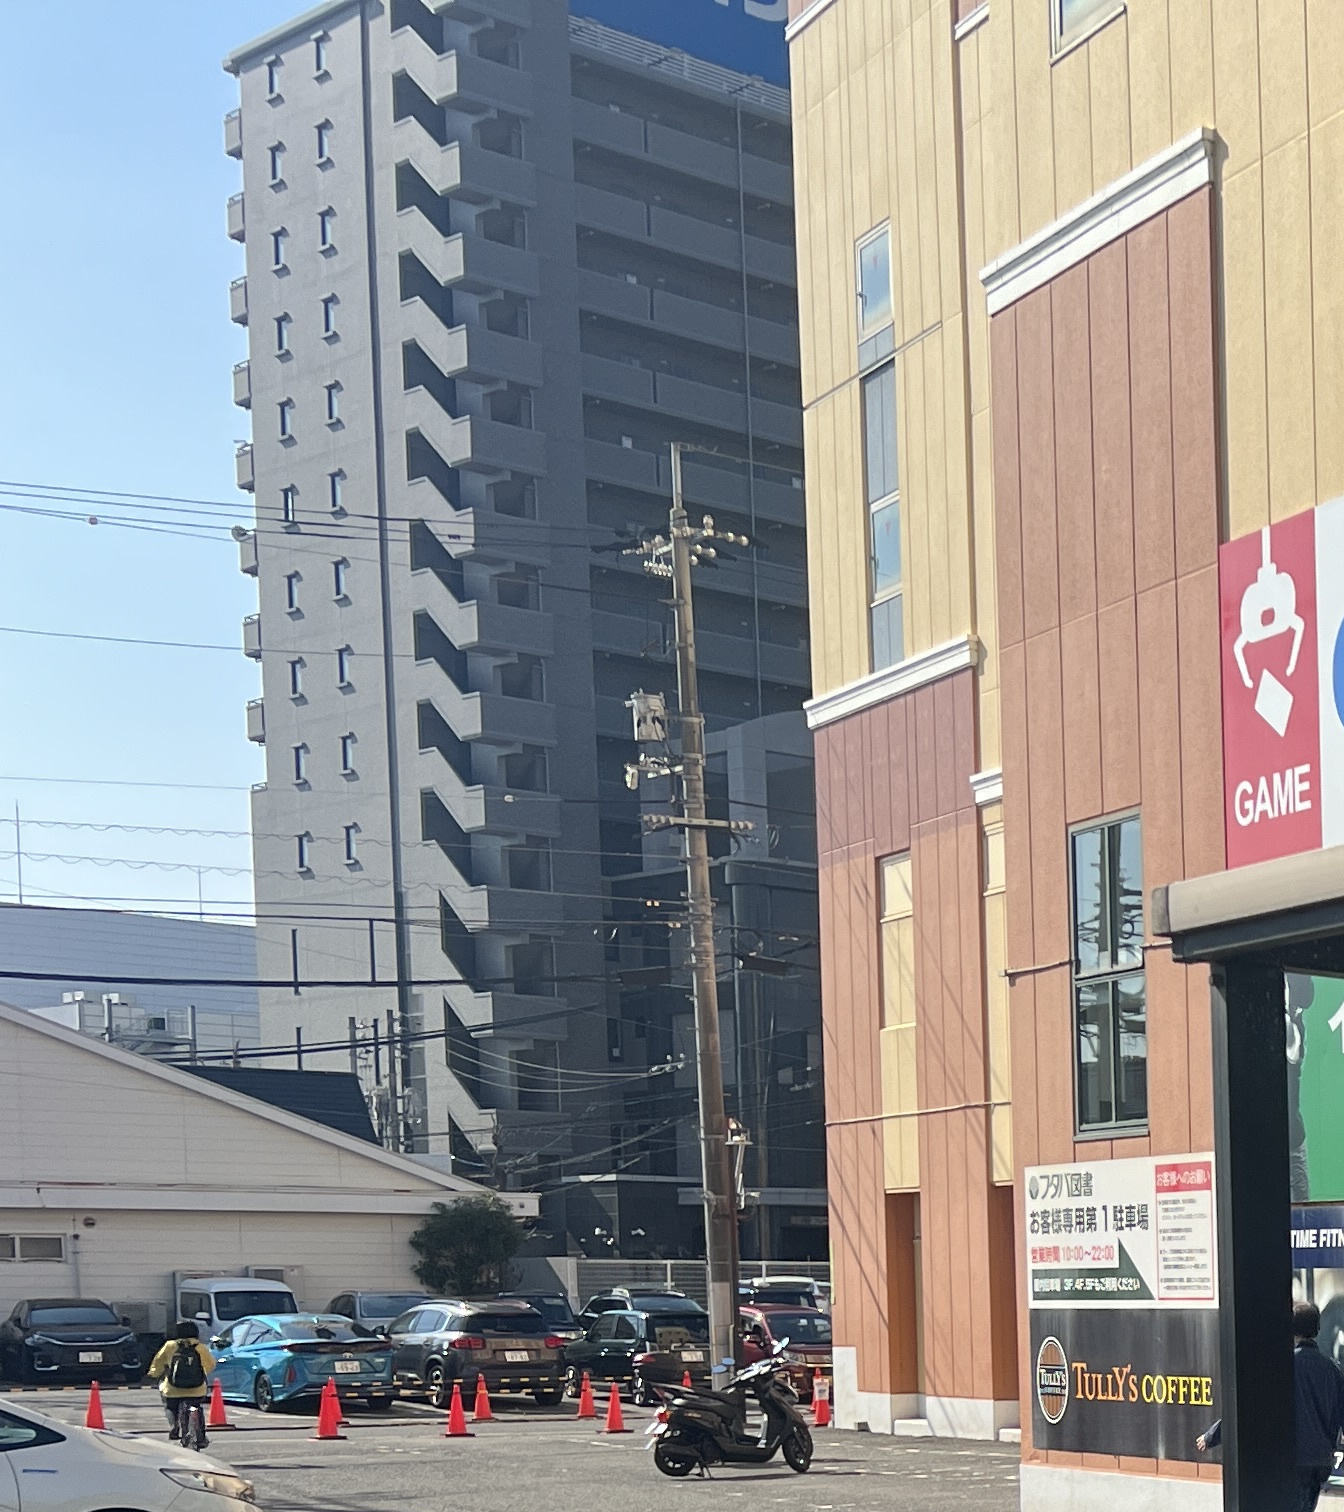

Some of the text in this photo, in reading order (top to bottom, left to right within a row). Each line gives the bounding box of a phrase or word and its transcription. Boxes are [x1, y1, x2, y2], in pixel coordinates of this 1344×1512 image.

[1235, 763, 1312, 826] GAME
[1039, 1171, 1093, 1200] フタバ図書
[1156, 1168, 1211, 1187] お客様へのお願い
[1290, 1229, 1317, 1249] TIME
[1141, 1373, 1214, 1406] COFFEE
